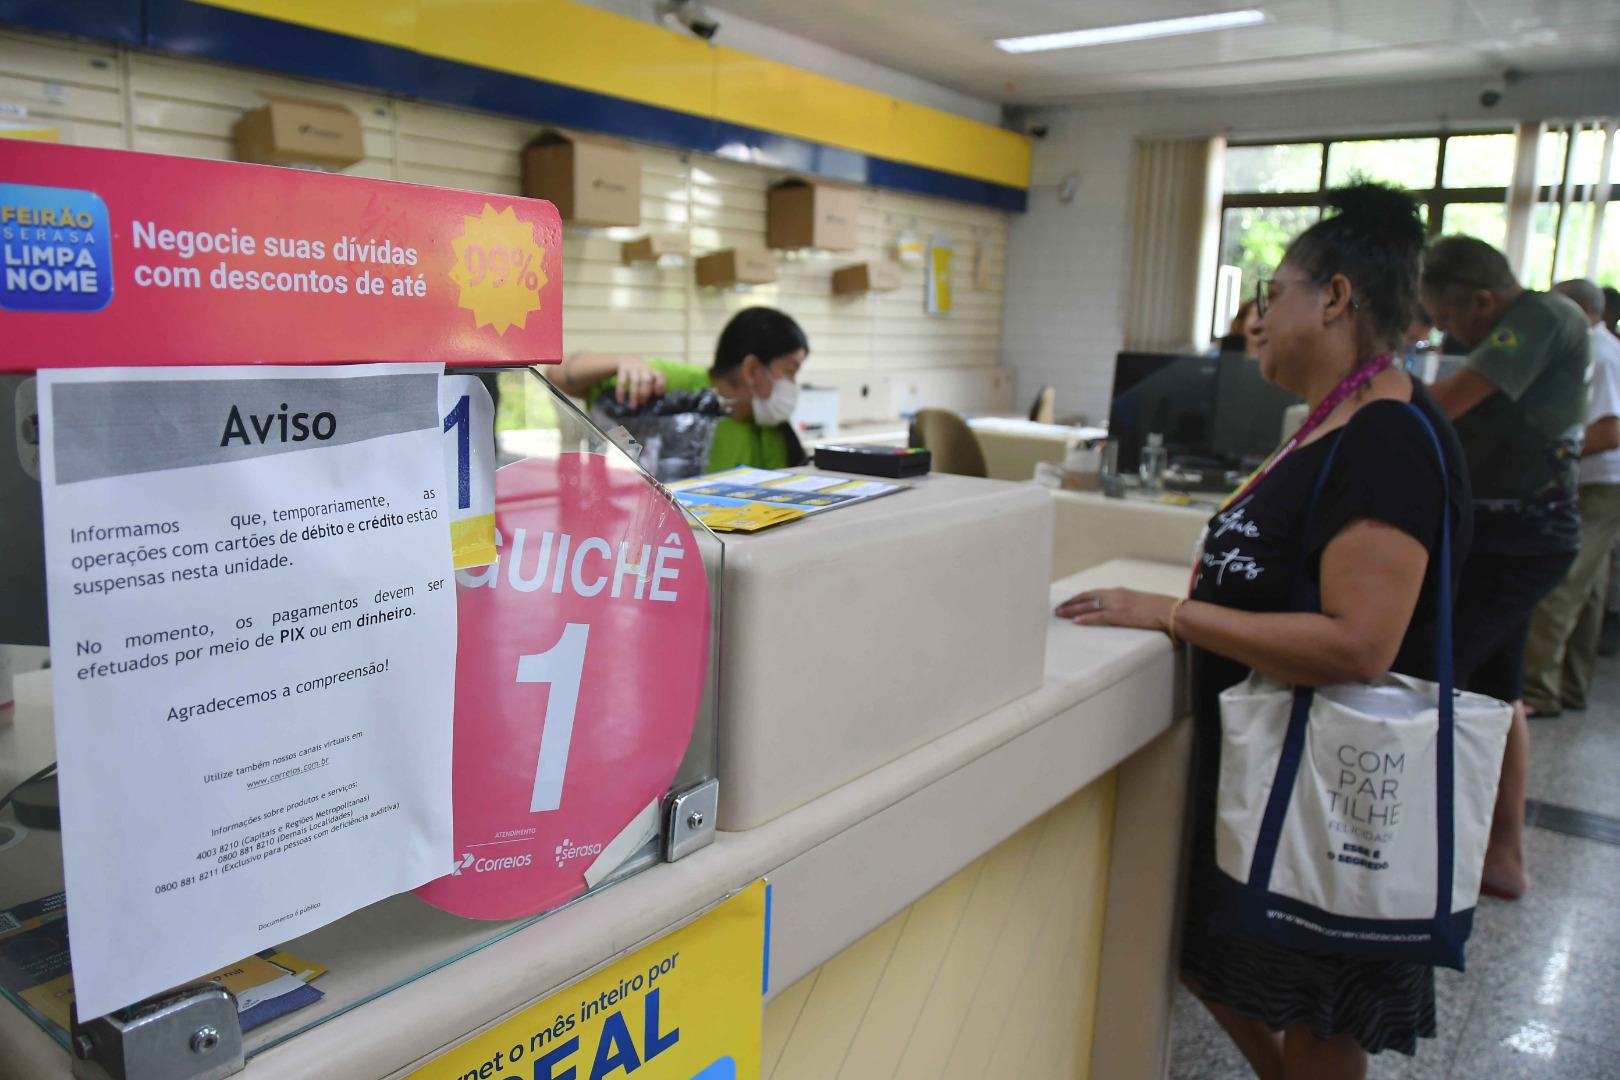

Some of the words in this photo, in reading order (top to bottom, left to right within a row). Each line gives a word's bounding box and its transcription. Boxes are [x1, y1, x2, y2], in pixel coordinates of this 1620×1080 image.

[1, 205, 93, 229] FEIRÃO
[4, 227, 95, 244] SERASA
[5, 245, 96, 268] LIMPA
[133, 220, 256, 259] Negocie
[264, 236, 325, 260] suas
[333, 236, 418, 266] dívidas
[6, 268, 98, 292] NOME
[134, 267, 202, 289] com
[209, 264, 348, 294] descontos
[355, 270, 383, 296] de
[391, 271, 427, 297] até
[464, 244, 538, 291] 99%
[220, 402, 337, 447] Aviso
[444, 395, 471, 509] 1
[70, 519, 180, 543] Informamos
[230, 511, 267, 529] que,
[273, 495, 391, 523] temporariamente,
[423, 488, 435, 500] as
[71, 546, 167, 570] operações
[172, 542, 208, 557] com
[215, 533, 275, 553] cartões
[280, 529, 298, 544] de
[301, 523, 344, 541] débito
[347, 523, 355, 533] e
[358, 514, 404, 532] crédito
[406, 509, 438, 524] estão
[73, 570, 165, 595] suspensas
[172, 565, 218, 582] nesta
[225, 554, 294, 575] unidade.
[76, 640, 102, 656] No
[125, 623, 215, 649] momento,
[235, 615, 252, 629] os
[272, 597, 358, 626] pagamentos
[374, 584, 414, 605] devem
[427, 578, 445, 593] ser
[77, 652, 169, 680] efetuados
[175, 646, 203, 665] por
[209, 637, 250, 656] meio
[255, 633, 274, 648] de
[280, 626, 305, 644] PIX
[310, 626, 327, 638] ou
[332, 618, 351, 633] em
[356, 608, 416, 629] dinheiro.
[167, 688, 277, 722] Agradecemos
[282, 686, 291, 697] a
[296, 659, 390, 696] compreensão!
[515, 622, 590, 813] 1
[203, 769, 233, 783] Utilize
[236, 760, 270, 776] também
[273, 752, 296, 765] nossos
[298, 745, 322, 757] canais
[324, 734, 350, 749] virtuais
[352, 731, 363, 739] em
[247, 757, 329, 790] www.correios.com.br
[1338, 744, 1405, 775] COM
[1327, 789, 1402, 826] TILHE
[1339, 769, 1398, 800] PAR
[196, 848, 217, 861] 4003
[220, 840, 239, 854] 8210
[241, 828, 276, 846] (Capitais
[285, 813, 314, 830] Regiões
[316, 794, 370, 820] Metropolitanas)
[211, 816, 261, 837] Informações
[263, 806, 285, 820] sobre
[286, 795, 319, 814] produtos
[327, 781, 358, 798] serviços:
[155, 882, 178, 894] 0800
[180, 876, 196, 887] 881
[199, 869, 219, 881] 8211
[221, 853, 262, 874] (Exclusivo
[263, 845, 281, 861] para
[283, 834, 312, 852] pessoas
[313, 828, 329, 840] com
[331, 814, 369, 835] deficiência
[370, 802, 400, 819] auditiva)
[217, 852, 237, 864] 0800
[240, 847, 253, 858] 881
[256, 839, 275, 851] 8210
[277, 828, 308, 844] (Demais
[309, 810, 354, 832] Localidades)
[495, 828, 536, 838] ATENDIMENTO
[475, 854, 531, 873] Correios
[561, 843, 601, 860] serasa
[258, 912, 293, 930] Documento
[295, 910, 299, 918] é
[300, 902, 321, 917] público
[509, 1044, 523, 1063] o
[531, 1016, 575, 1053] mês
[581, 975, 643, 1023] inteiro
[648, 951, 679, 989] por
[503, 987, 680, 1080] EAL
